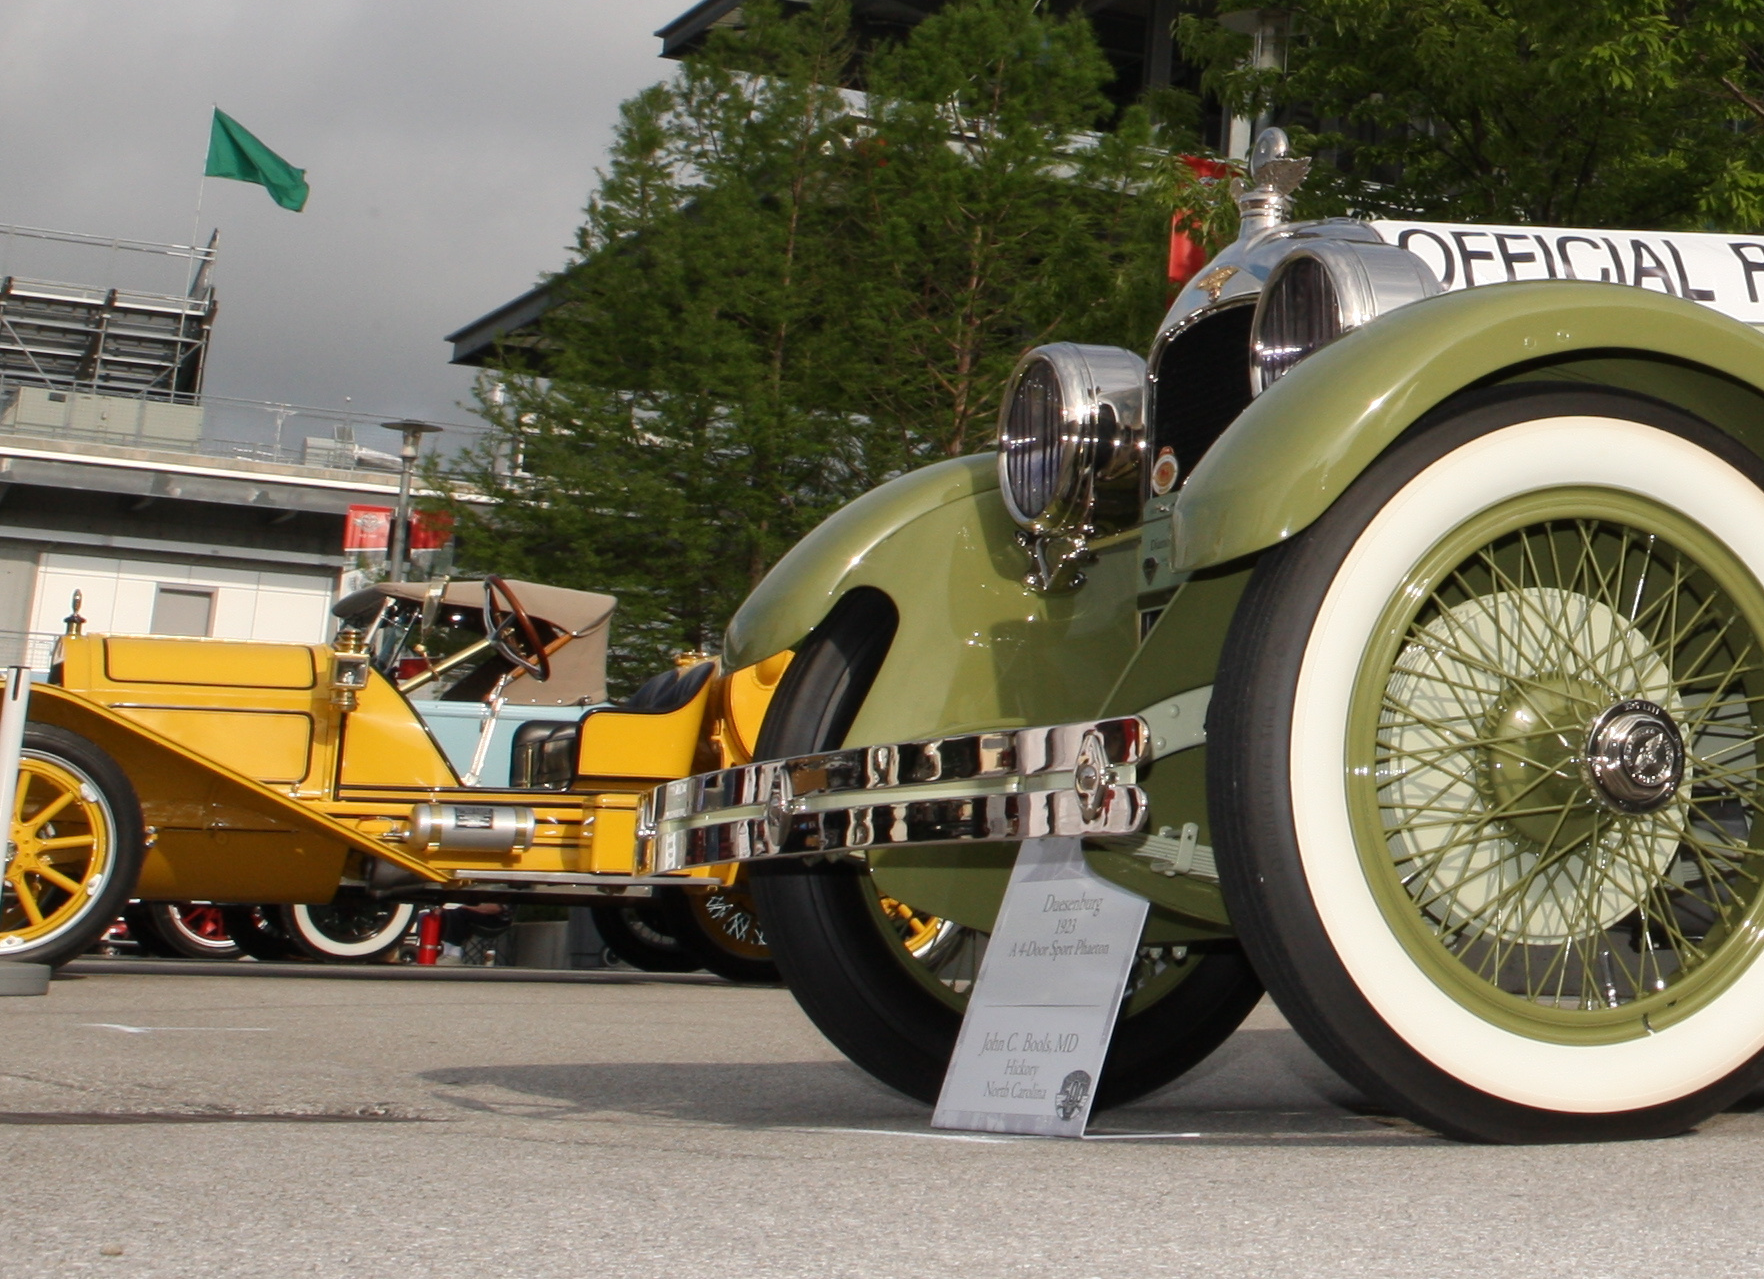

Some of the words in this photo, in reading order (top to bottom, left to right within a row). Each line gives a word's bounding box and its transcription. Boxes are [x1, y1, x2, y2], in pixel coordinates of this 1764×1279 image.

[1398, 228, 1716, 302] OFFICIAL
[1055, 918, 1077, 934] 1923
[978, 1032, 1005, 1056] John
[1054, 1033, 1079, 1053] MD
[1004, 1059, 1040, 1081] Hickory
[984, 1081, 1009, 1098] North
[1011, 1082, 1047, 1099] Carolina
